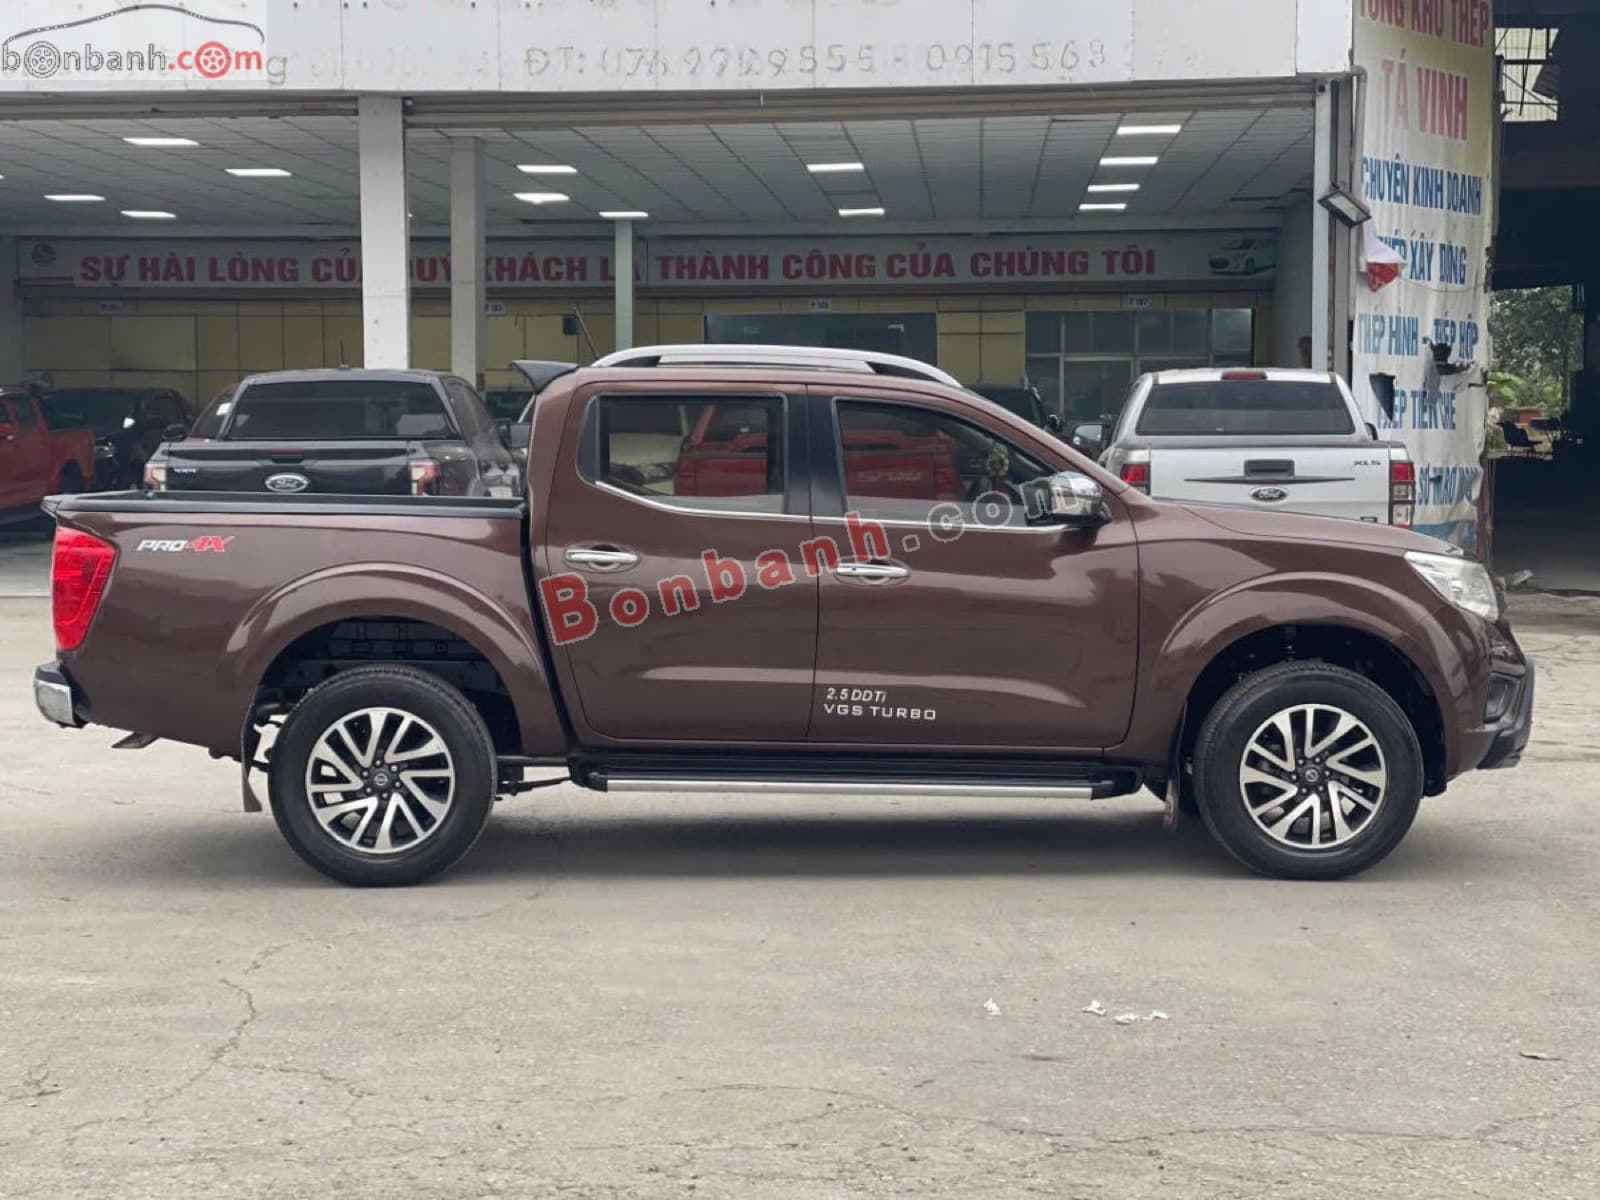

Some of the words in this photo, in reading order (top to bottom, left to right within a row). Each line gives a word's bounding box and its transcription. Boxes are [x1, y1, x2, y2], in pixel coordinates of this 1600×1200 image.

[1416, 66, 1469, 142] VINH
[1412, 165, 1445, 209] KINH
[80, 254, 131, 289] SỰ
[138, 251, 196, 283] HÀI
[208, 251, 299, 283] LÒNG
[311, 247, 363, 283] CỦ
[655, 249, 770, 281] THÀNH
[782, 248, 877, 280] CÔNG
[885, 242, 956, 279] CỦA
[969, 246, 1089, 278] CHÚNG
[1102, 244, 1156, 275] TÔI
[823, 703, 863, 716] VGS
[869, 706, 936, 720] TURBO
